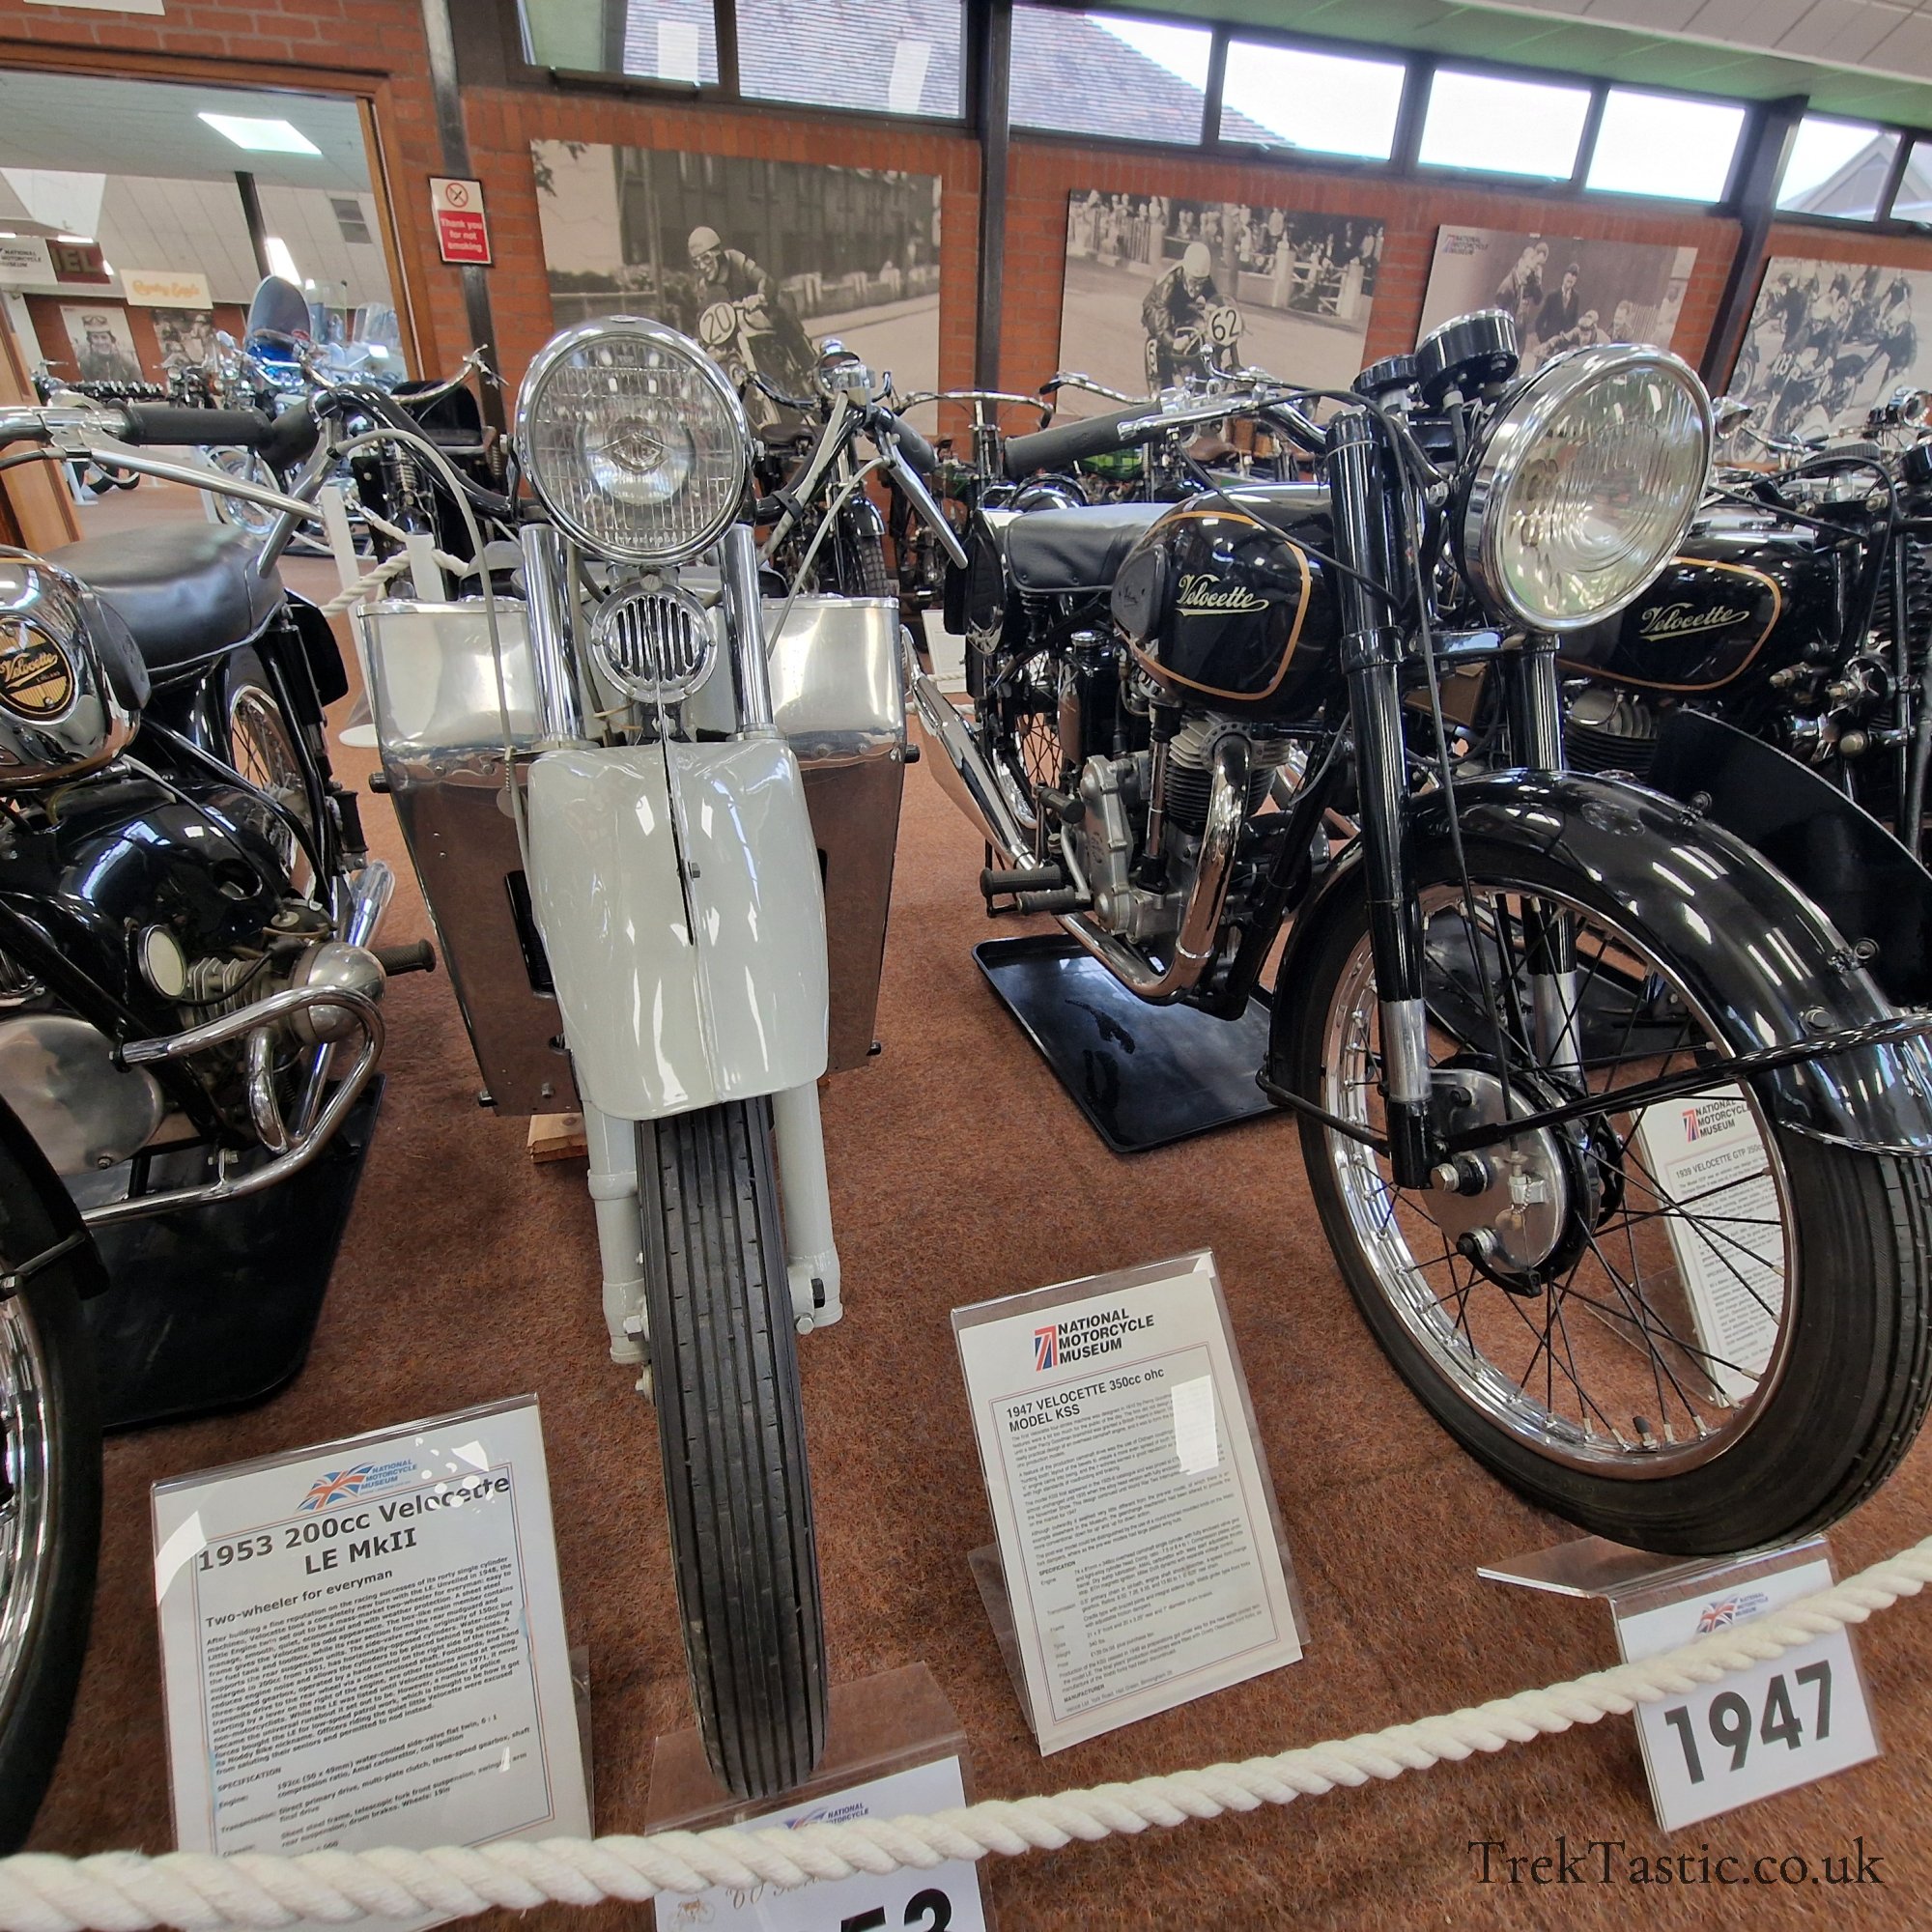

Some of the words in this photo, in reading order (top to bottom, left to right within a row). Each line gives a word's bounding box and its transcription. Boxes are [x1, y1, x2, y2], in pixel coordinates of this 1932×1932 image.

[702, 304, 733, 344] 20
[1211, 309, 1240, 342] 62
[1176, 574, 1269, 615] Velocette
[1639, 602, 1750, 641] Velocette
[0, 652, 58, 688] Velocette
[1697, 1104, 1747, 1126] MOTORCYCL
[1699, 1119, 1736, 1138] MUSEUM
[1675, 1167, 1692, 1179] 1939
[1691, 1152, 1732, 1174] VELOCETTE
[1732, 1148, 1747, 1159] GTP
[1058, 1308, 1129, 1336] NATIONAL
[1059, 1315, 1154, 1350] MOTORCYCLE
[1060, 1338, 1122, 1364] MUSEUM
[1007, 1403, 1034, 1419] 1947
[1036, 1382, 1107, 1410] VELOCETTE
[1109, 1376, 1142, 1391] 350cc
[1144, 1368, 1165, 1381] ohc
[1009, 1411, 1053, 1433] MODEL
[1056, 1404, 1081, 1420] KSS
[360, 1475, 398, 1490] MUSEUM
[366, 1463, 417, 1481] MOTORCYCLE
[372, 1459, 412, 1474] NATIONAL
[199, 1535, 273, 1572] 1953
[285, 1513, 370, 1548] 200cc
[304, 1548, 338, 1575] LE
[349, 1527, 417, 1563] MkII
[206, 1595, 298, 1628] Two-wheeler
[302, 1588, 322, 1602] for
[327, 1570, 392, 1595] everyman
[207, 1634, 226, 1644] After
[228, 1625, 261, 1639] building
[269, 1618, 284, 1627] fine
[286, 1606, 327, 1623] reputation
[354, 1592, 377, 1605] racing
[379, 1582, 415, 1596] successes
[437, 1571, 455, 1581] rorty
[457, 1564, 478, 1576] single
[479, 1556, 507, 1569] cylinder
[208, 1650, 228, 1661] Little
[230, 1641, 257, 1655] Engine
[259, 1636, 276, 1646] twin
[335, 1605, 384, 1624] mass-market
[386, 1592, 432, 1609] two-wheeler
[486, 1574, 501, 1582] easy
[249, 1625, 286, 1640] Velocette
[287, 1620, 304, 1630] took
[314, 1605, 355, 1623] completely
[374, 1596, 390, 1605] turn
[392, 1591, 409, 1600] with
[437, 1575, 468, 1587] Unveiled
[302, 1625, 345, 1641] economical
[363, 1614, 380, 1624] with
[382, 1605, 412, 1619] weather
[462, 1585, 481, 1596] sheet
[483, 1580, 500, 1590] steel
[209, 1664, 232, 1677] frame
[234, 1659, 255, 1670] gives
[272, 1643, 308, 1659] Velocette
[401, 1607, 431, 1621] box-like
[433, 1602, 450, 1612] main
[452, 1593, 481, 1606] member
[483, 1584, 513, 1598] contains
[210, 1678, 244, 1693] supports
[262, 1669, 277, 1678] rear
[280, 1655, 324, 1673] suspension
[365, 1632, 403, 1648] side-valve
[433, 1613, 467, 1629] originally
[478, 1604, 498, 1614] 150cc
[224, 1670, 240, 1680] fuel
[242, 1665, 259, 1675] tank
[312, 1644, 332, 1655] while
[346, 1636, 361, 1645] rear
[364, 1627, 390, 1639] section
[392, 1621, 413, 1632] forms
[430, 1612, 444, 1621] rear
[446, 1601, 483, 1617] mudguard
[1664, 1660, 1832, 1785] 1947
[828, 1803, 865, 1819] NATIONAL
